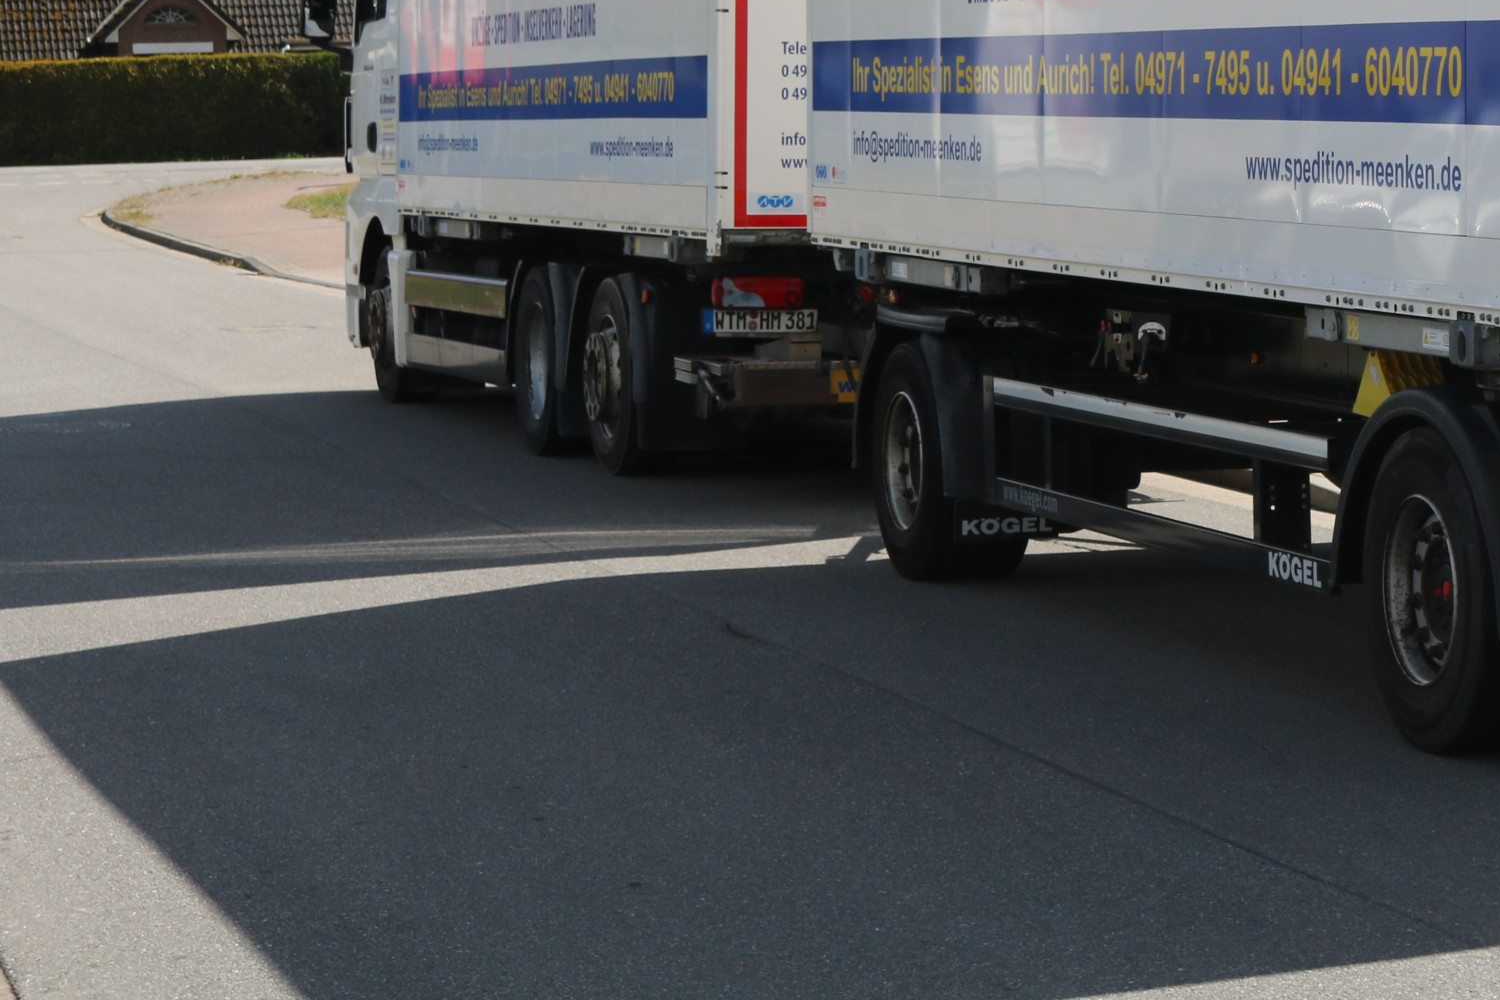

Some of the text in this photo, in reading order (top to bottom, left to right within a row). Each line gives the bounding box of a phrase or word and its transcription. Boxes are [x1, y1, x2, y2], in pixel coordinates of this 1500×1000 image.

[567, 3, 595, 38] LAGERUNG
[782, 65, 789, 77] 0
[852, 45, 1462, 102] Ihr Spezialist in Esens und Aurich! Tel. 04971 7495 u. 04941 6040770
[782, 88, 789, 100] 0
[853, 130, 982, 163] info@spedition-meenken.de
[1246, 152, 1462, 192] www.spedition-meenken.de
[715, 311, 815, 330] WTM HM 381
[961, 516, 1052, 536] KÖGEL
[1268, 552, 1321, 588] KÖGEL
